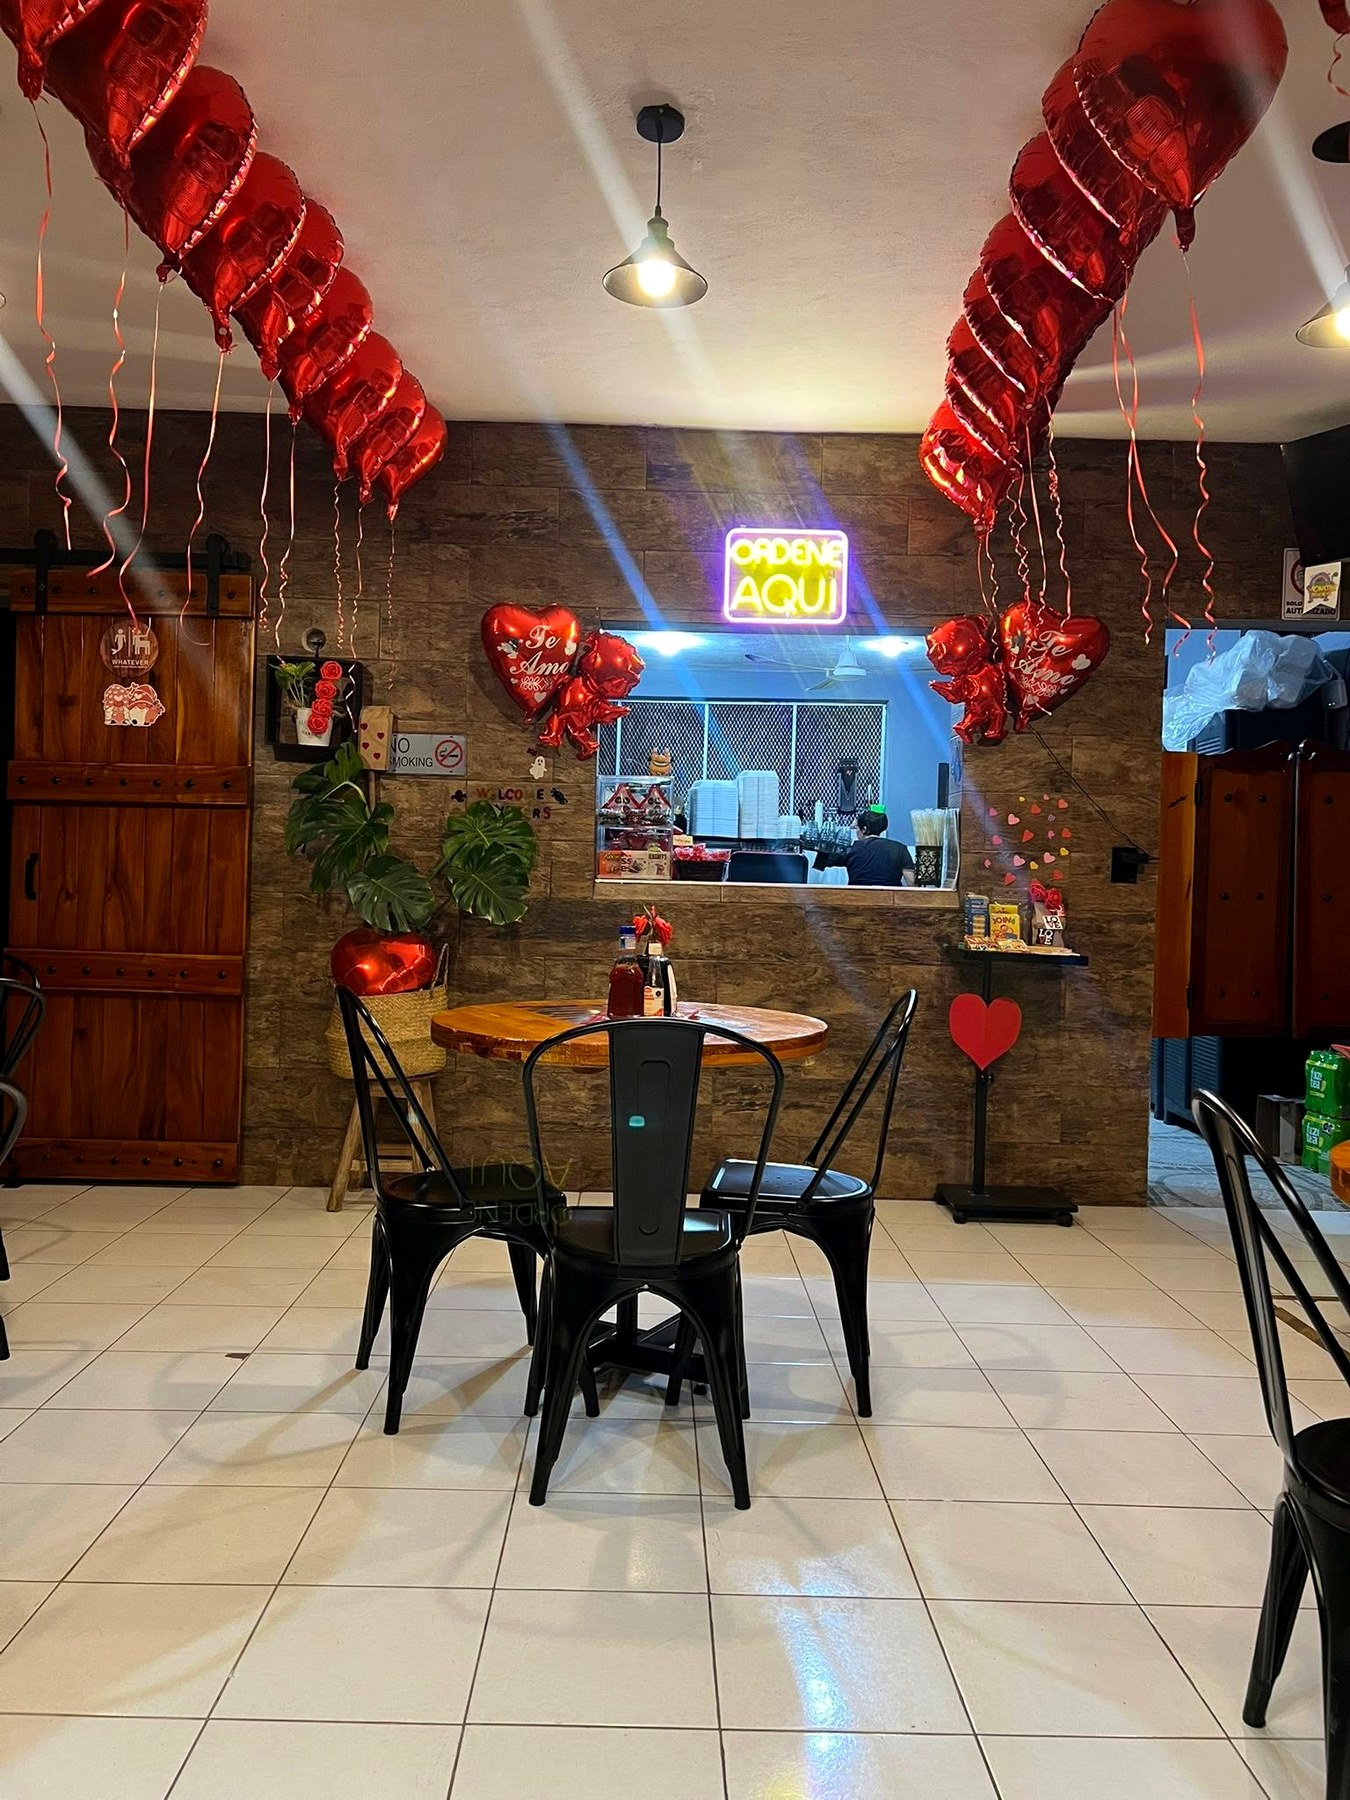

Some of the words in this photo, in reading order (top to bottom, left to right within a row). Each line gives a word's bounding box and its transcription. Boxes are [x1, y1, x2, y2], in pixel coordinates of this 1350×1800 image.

[731, 537, 843, 567] ORDENE
[729, 573, 837, 615] AQUI
[1286, 607, 1336, 615] AUTRIZADO
[525, 624, 561, 649] Te
[1030, 630, 1073, 656] Te
[509, 651, 569, 675] Amo
[390, 737, 410, 753] NO
